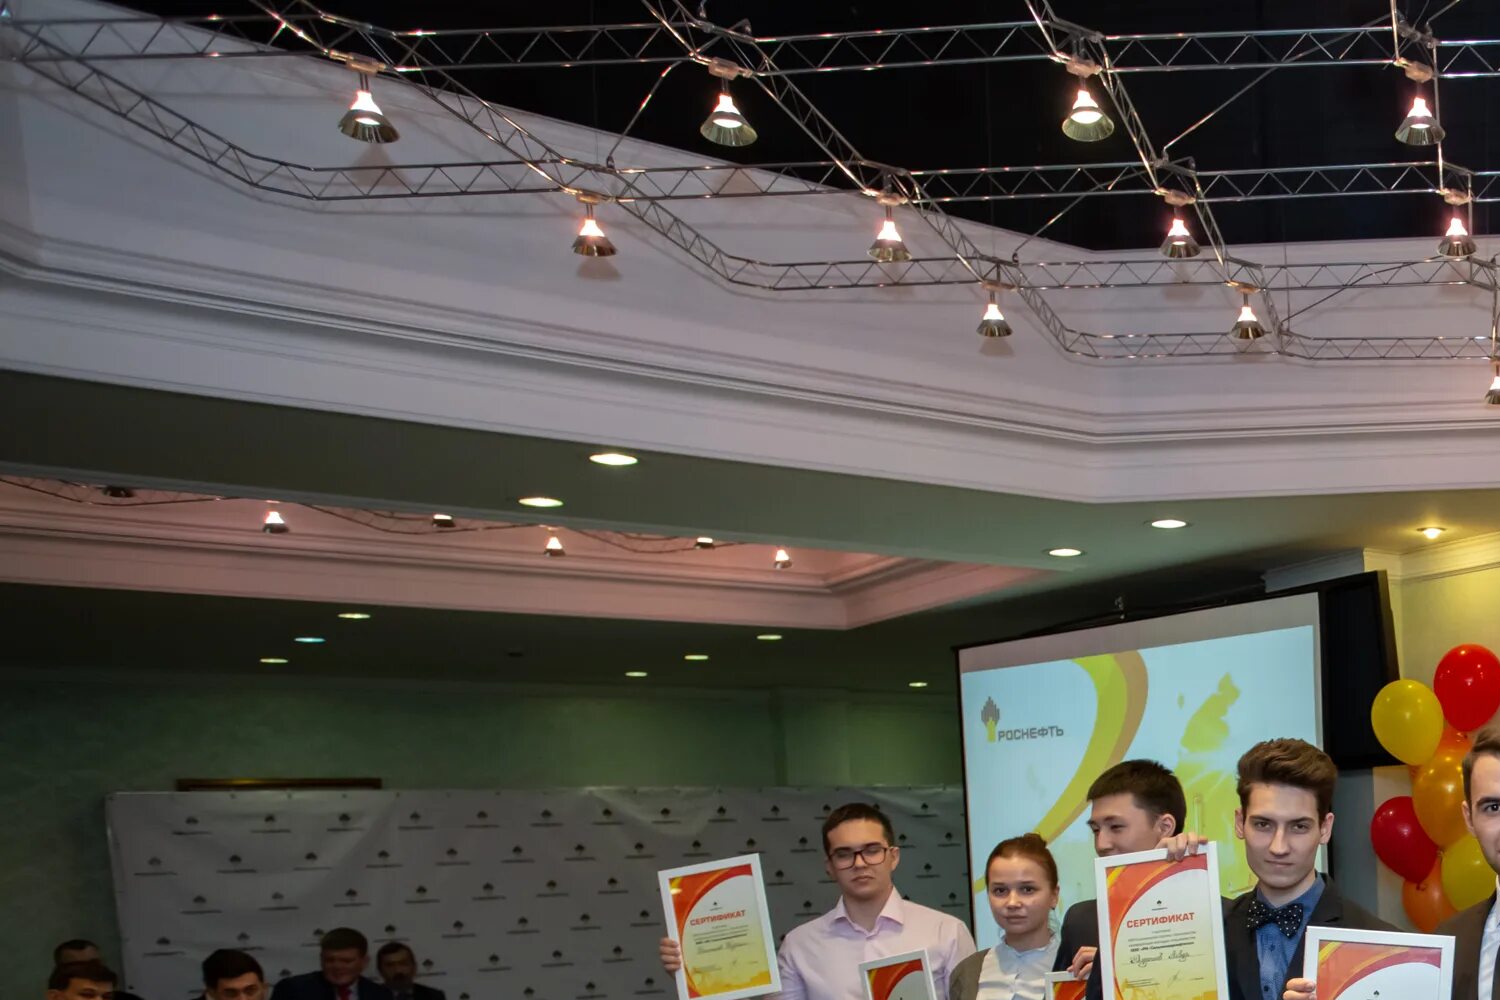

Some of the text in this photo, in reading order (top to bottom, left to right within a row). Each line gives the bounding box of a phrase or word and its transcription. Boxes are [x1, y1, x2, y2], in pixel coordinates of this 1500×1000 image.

[997, 725, 1064, 742] РОСНЕФТЬ
[690, 910, 746, 926] СЕРТИФИКАТ
[1126, 912, 1195, 928] СЕРТИФИКАТ
